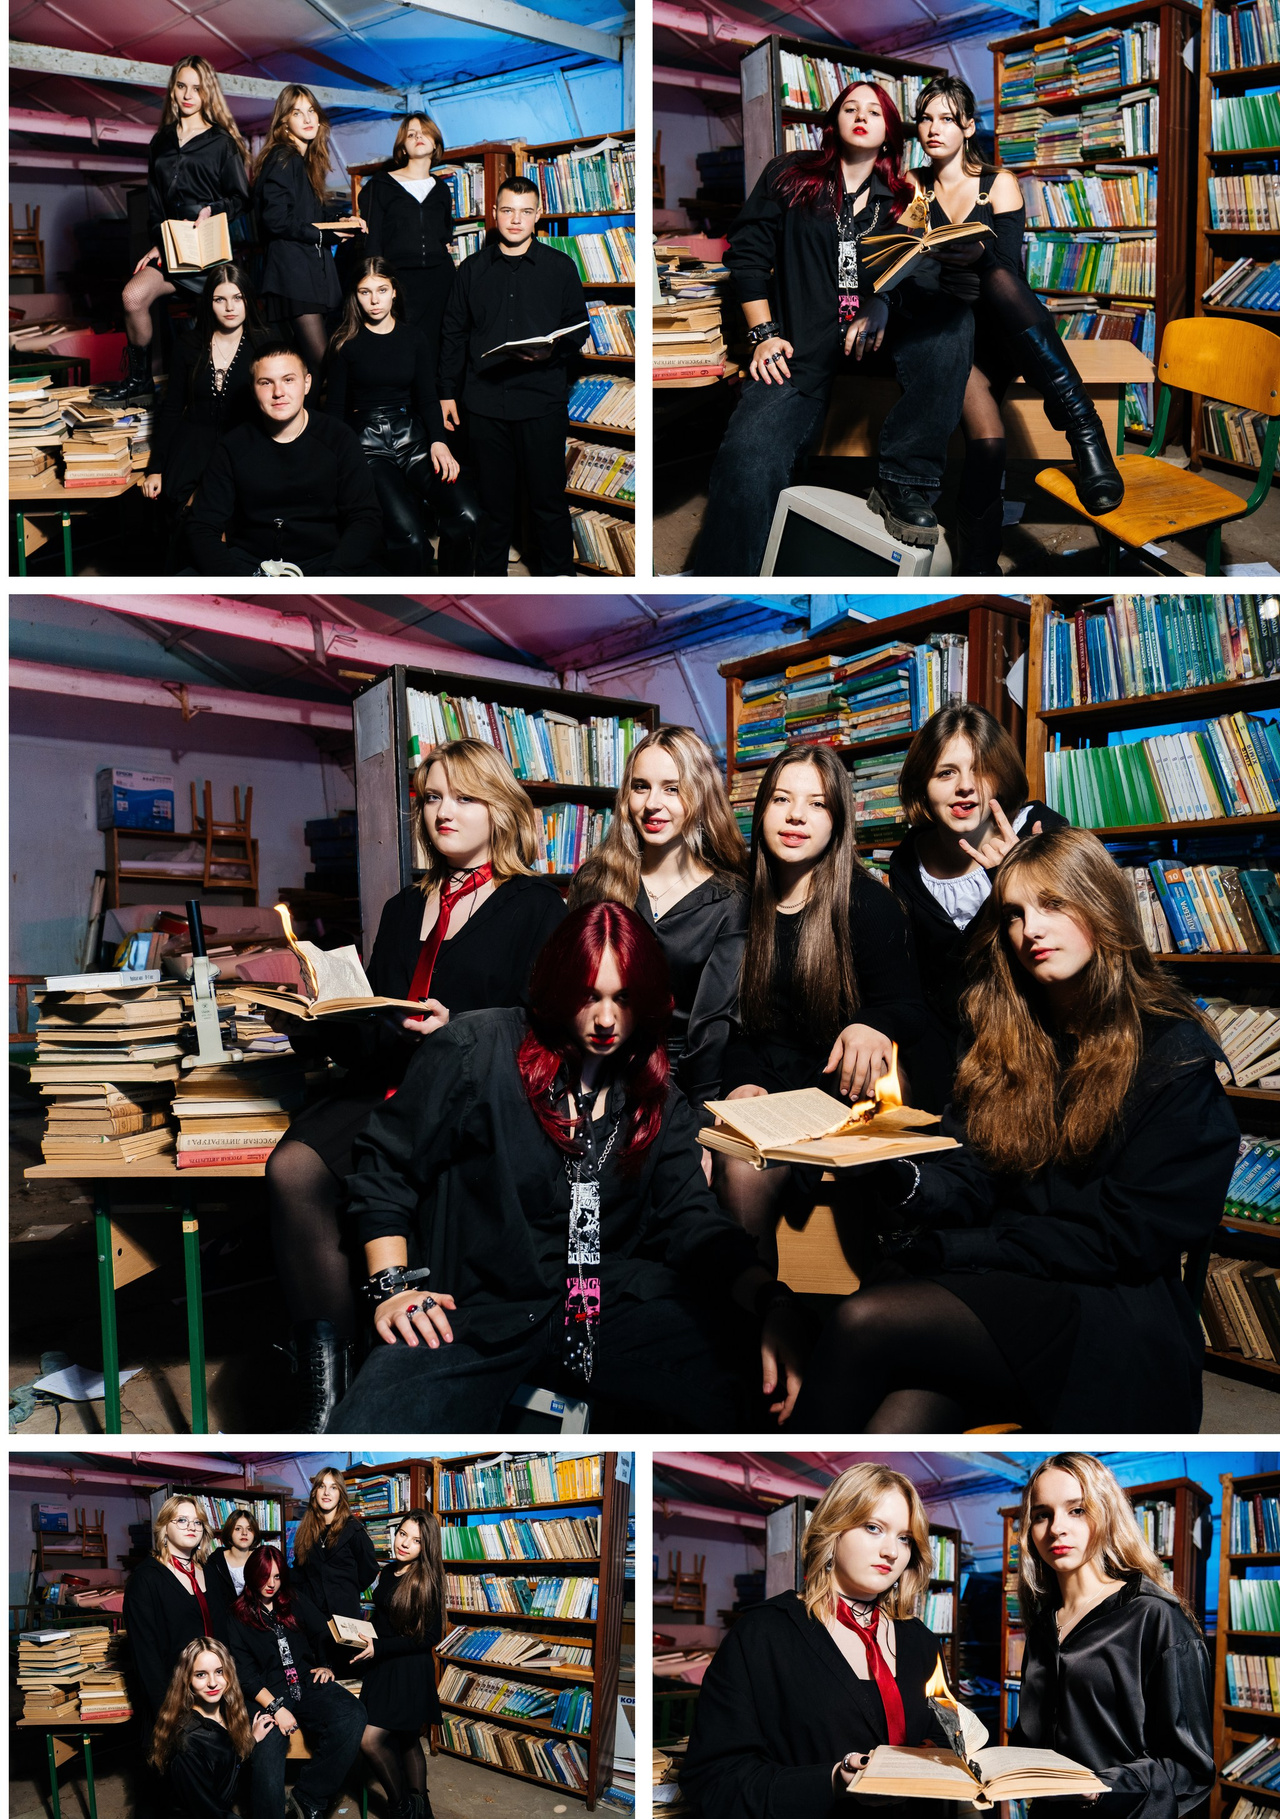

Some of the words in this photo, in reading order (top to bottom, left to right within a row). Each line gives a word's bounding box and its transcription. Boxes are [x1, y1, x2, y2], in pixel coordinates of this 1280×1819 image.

[116, 770, 133, 778] EPSON
[1168, 872, 1178, 881] 10
[1180, 899, 1196, 930] АЛГЕБРА
[1250, 1059, 1277, 1076] УКРАЇНСЬКА
[192, 1138, 240, 1146] ЛИТЕРАТУРА
[243, 1137, 278, 1145] РУССКАЯ
[1254, 1146, 1261, 1155] 9
[1267, 1149, 1274, 1158] 9
[221, 1155, 242, 1163] РУССКАЯ
[1232, 1161, 1250, 1184] ГЕОМЕТРІЯ
[1242, 1164, 1262, 1186] ГЕОМЕТРІЯ
[1255, 1167, 1276, 1190] ГЕОМЕТРІЯ
